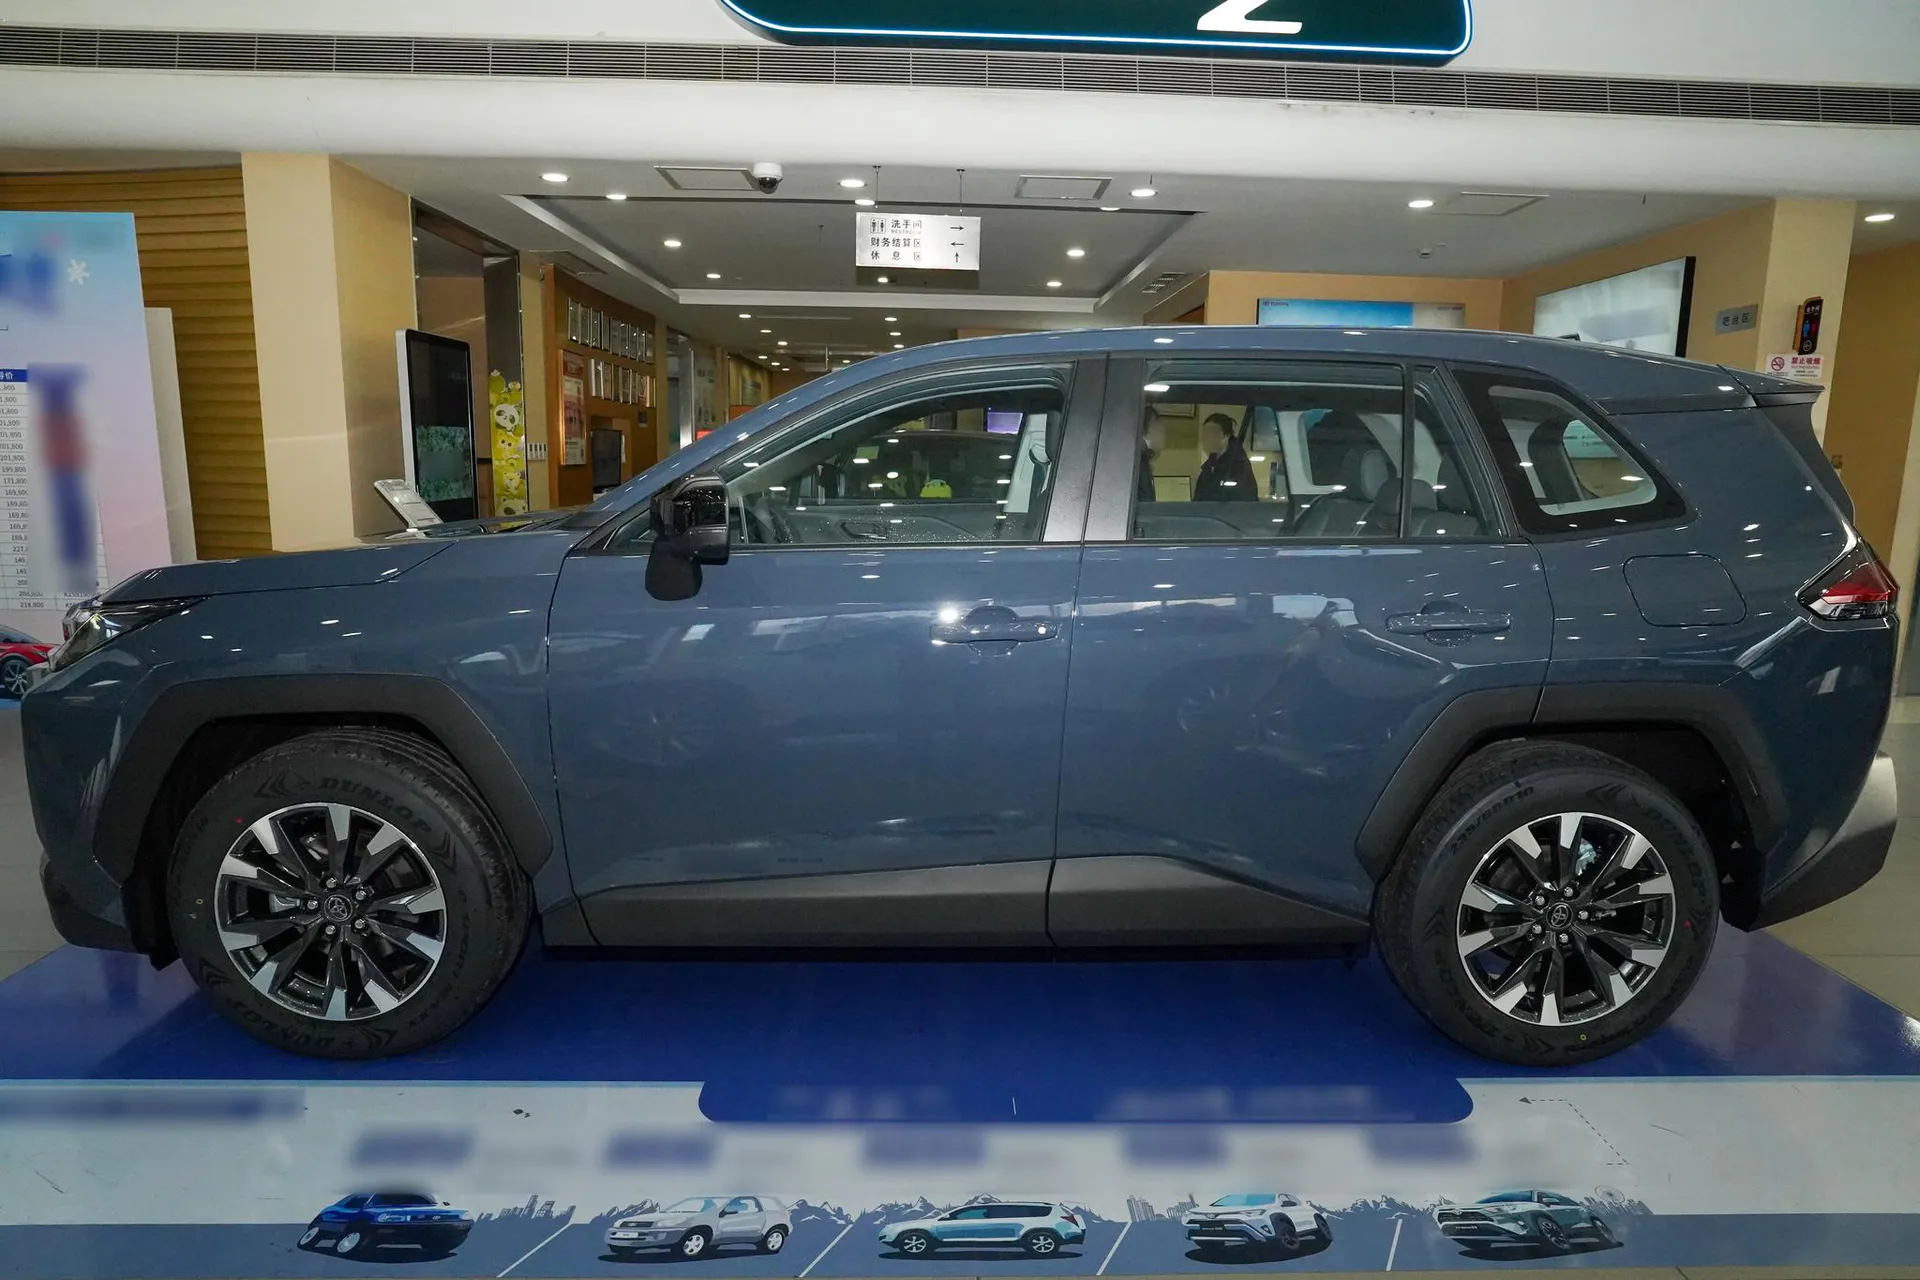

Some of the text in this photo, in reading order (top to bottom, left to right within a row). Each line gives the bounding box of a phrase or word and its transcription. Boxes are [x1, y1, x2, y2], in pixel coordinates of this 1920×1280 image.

[891, 219, 922, 229] 洗手间
[870, 237, 921, 248] 财务结算区
